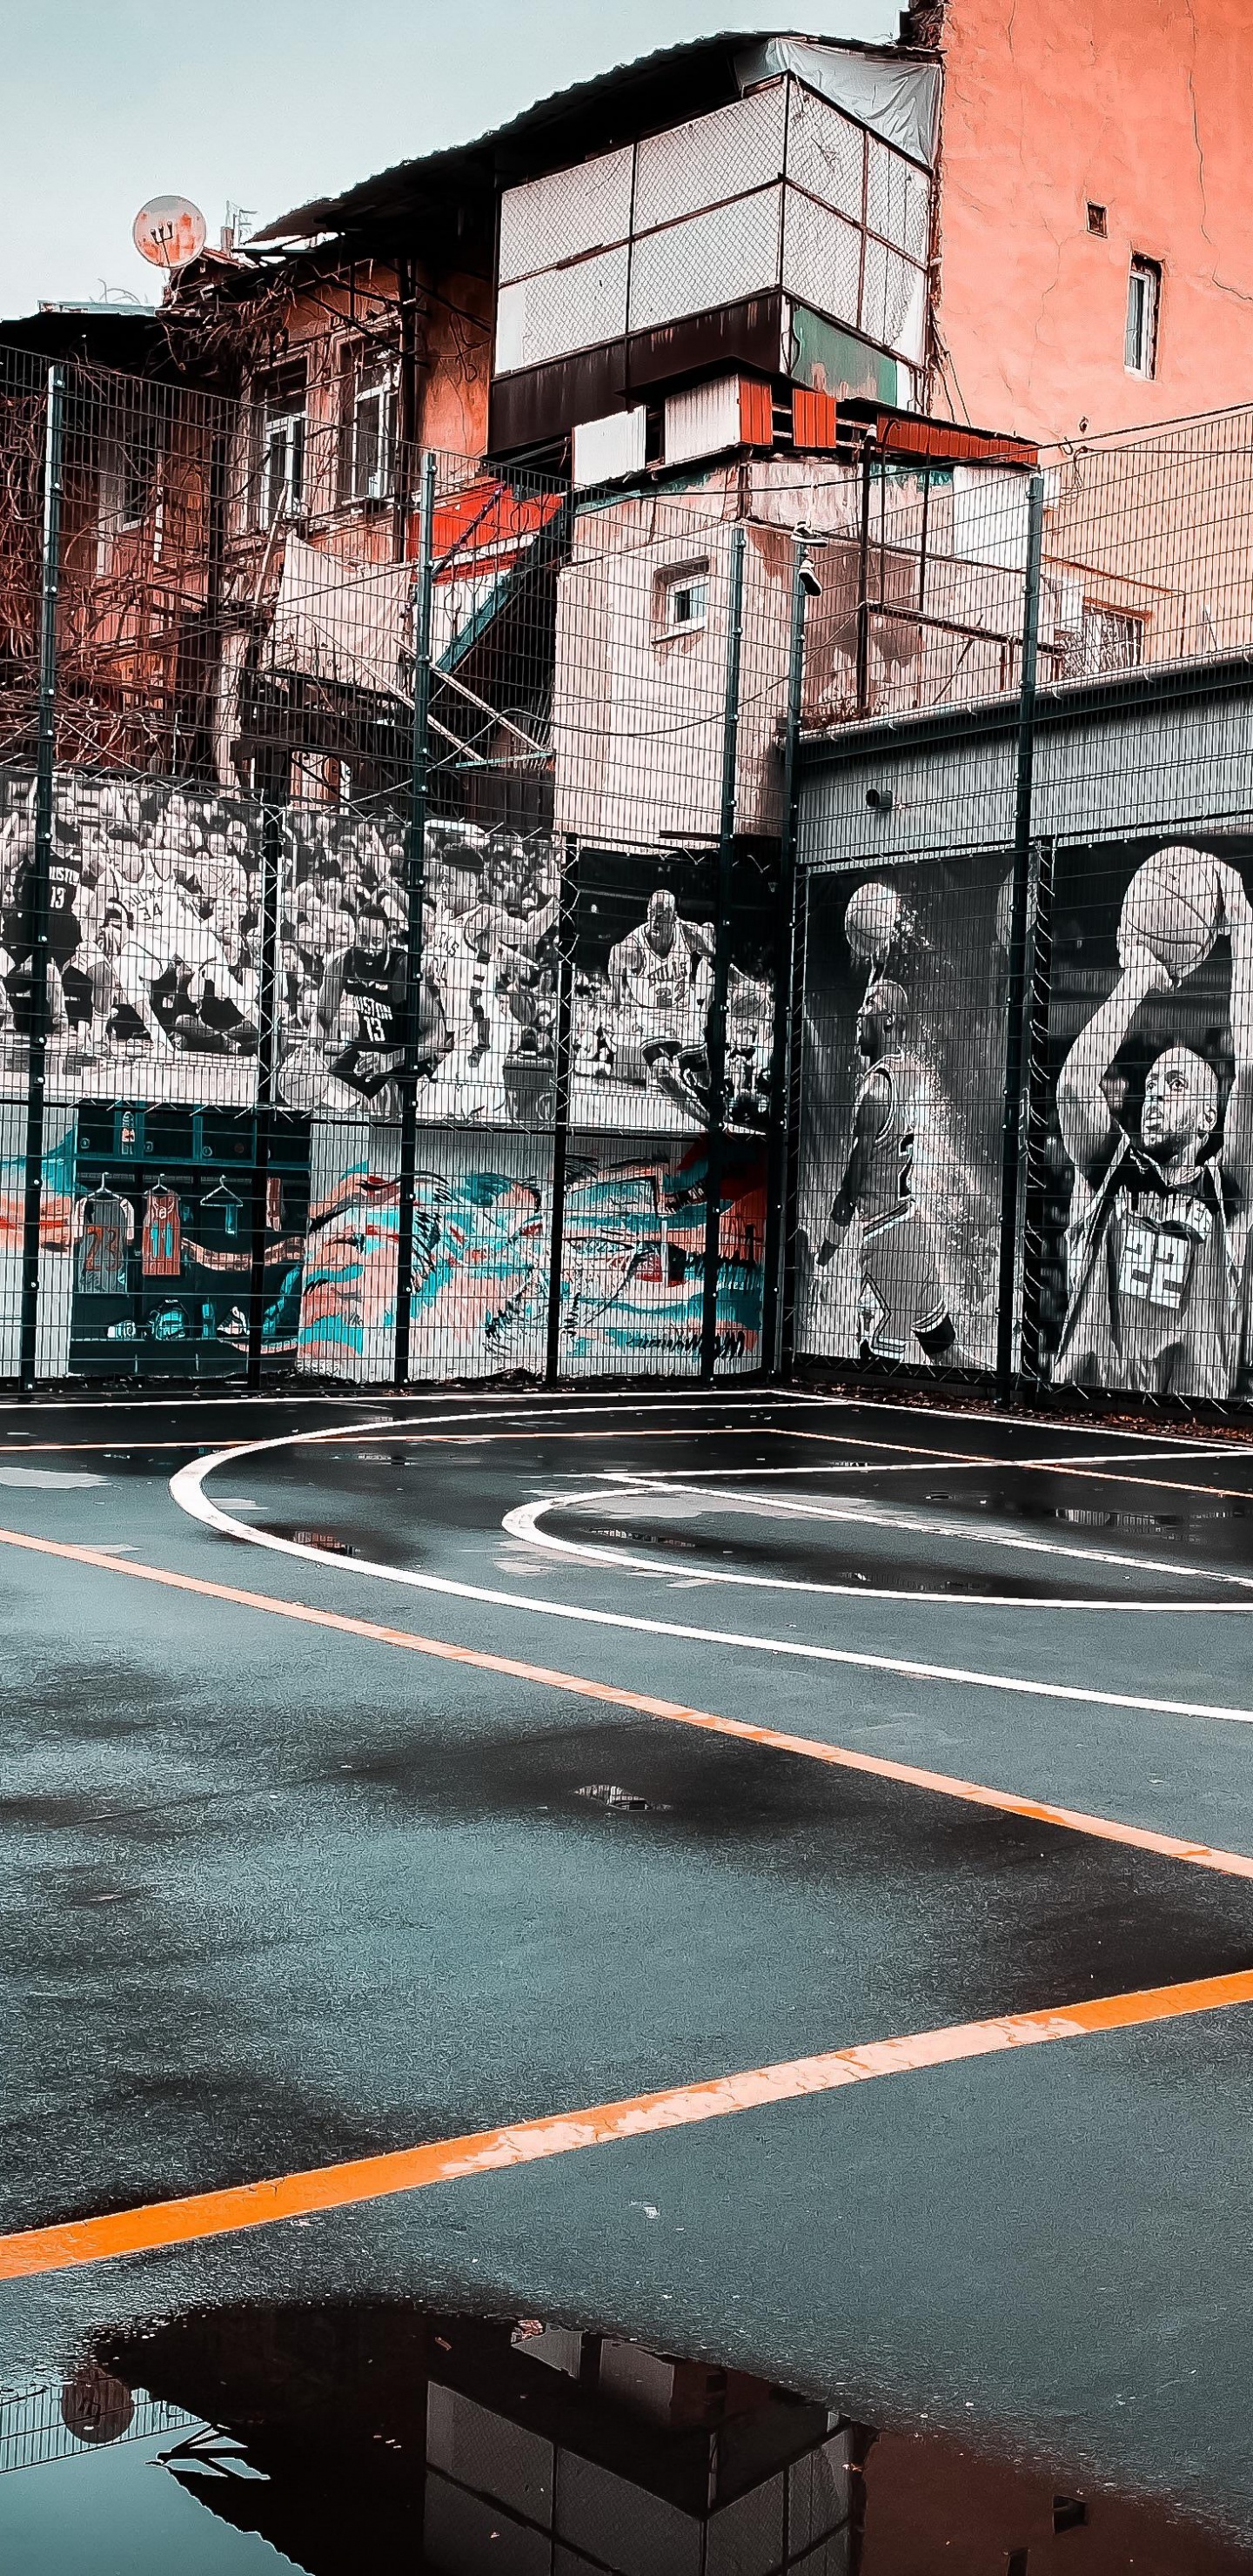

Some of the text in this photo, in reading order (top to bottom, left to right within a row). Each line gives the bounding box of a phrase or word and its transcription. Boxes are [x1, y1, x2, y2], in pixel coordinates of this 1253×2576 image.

[51, 886, 67, 909] 13
[138, 902, 163, 922] 34
[363, 1016, 385, 1042] 13
[85, 1225, 121, 1272] 23
[151, 1220, 173, 1258] 11
[1118, 1222, 1189, 1310] 22
